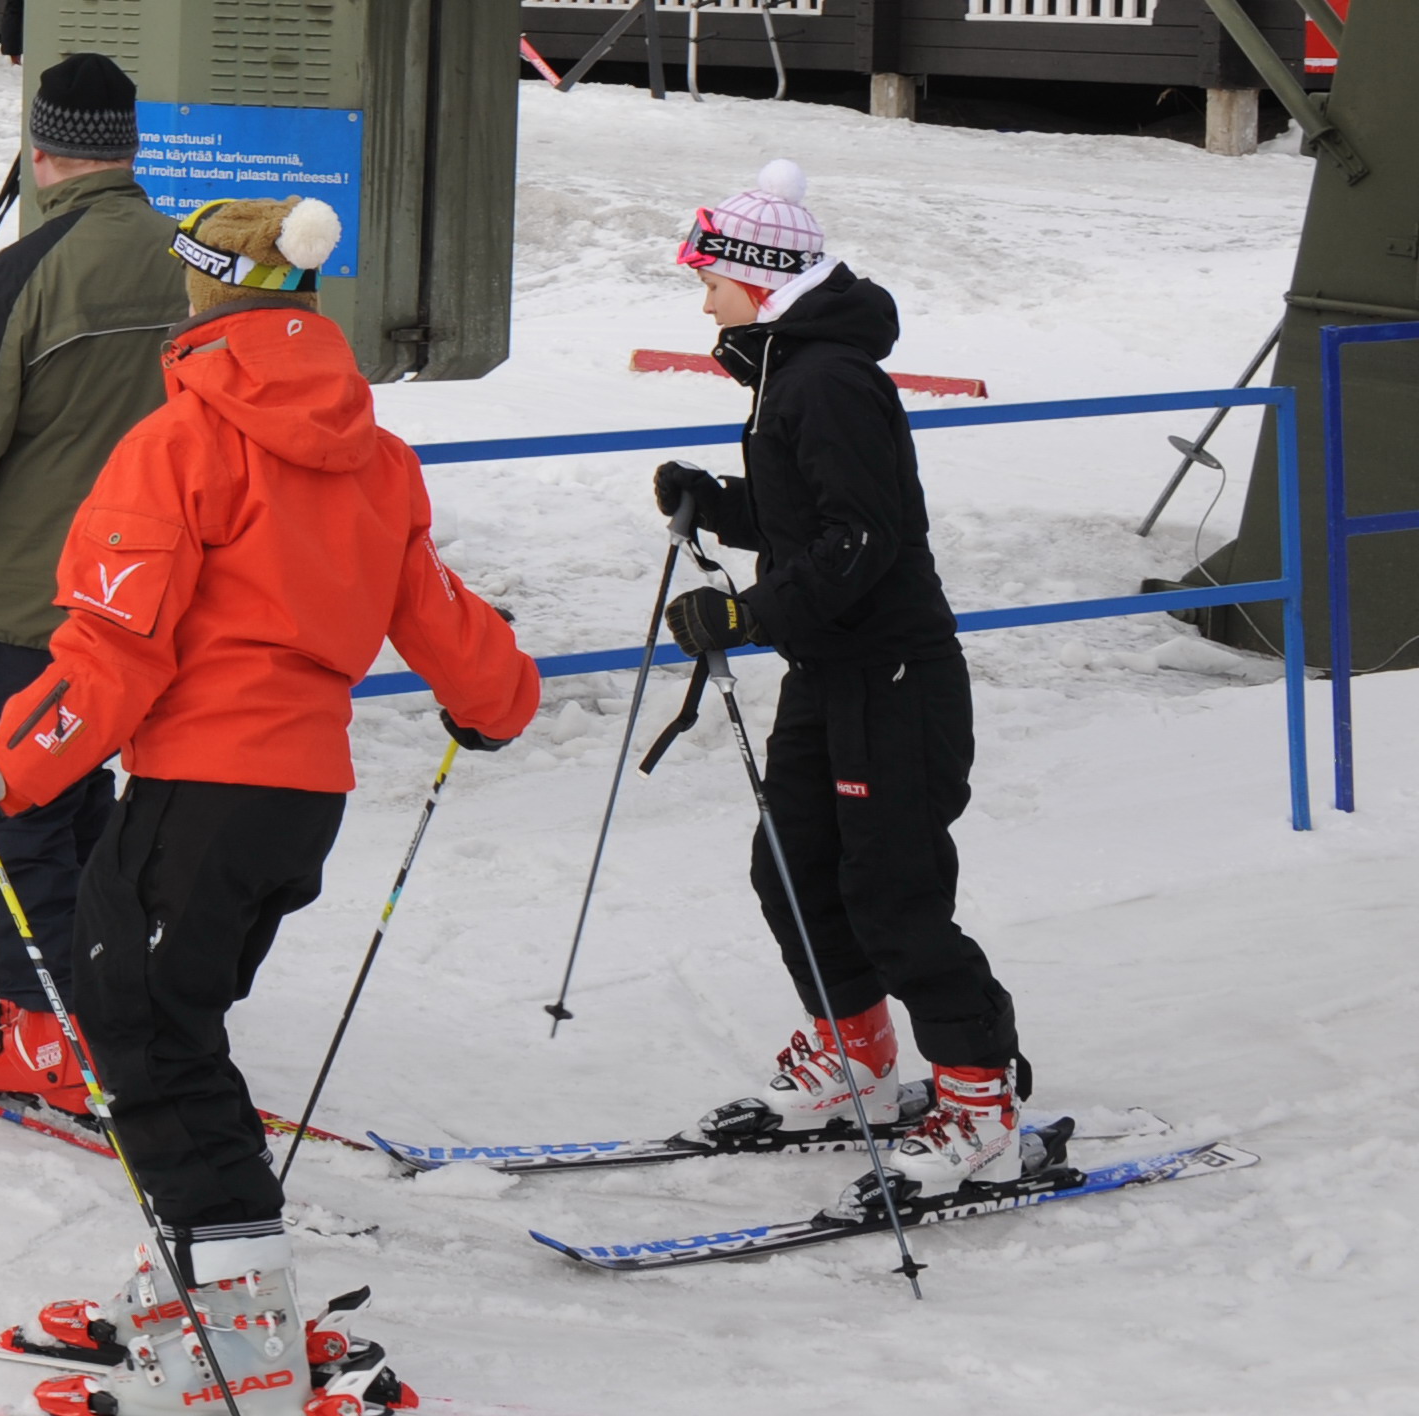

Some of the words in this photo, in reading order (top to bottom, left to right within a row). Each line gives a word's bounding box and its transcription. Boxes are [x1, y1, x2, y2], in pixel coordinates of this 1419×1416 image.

[139, 133, 160, 144] nne
[163, 133, 215, 146] vastuusi
[137, 147, 164, 159] uista
[166, 149, 213, 163] käyttää
[216, 151, 304, 166] karkuremmiä,
[134, 165, 147, 175] un
[149, 165, 187, 178] irroitat
[190, 166, 234, 180] laudan
[236, 168, 280, 182] jalasta
[282, 170, 342, 184] rinteessä
[155, 195, 176, 208] ditt
[173, 234, 232, 276] SCOTT
[704, 237, 797, 270] SHRED
[37, 969, 78, 1041] SCOTT
[716, 1111, 756, 1129] ATOMIC
[918, 1191, 1055, 1225] ATOMIC
[182, 1369, 294, 1407] HEAD
